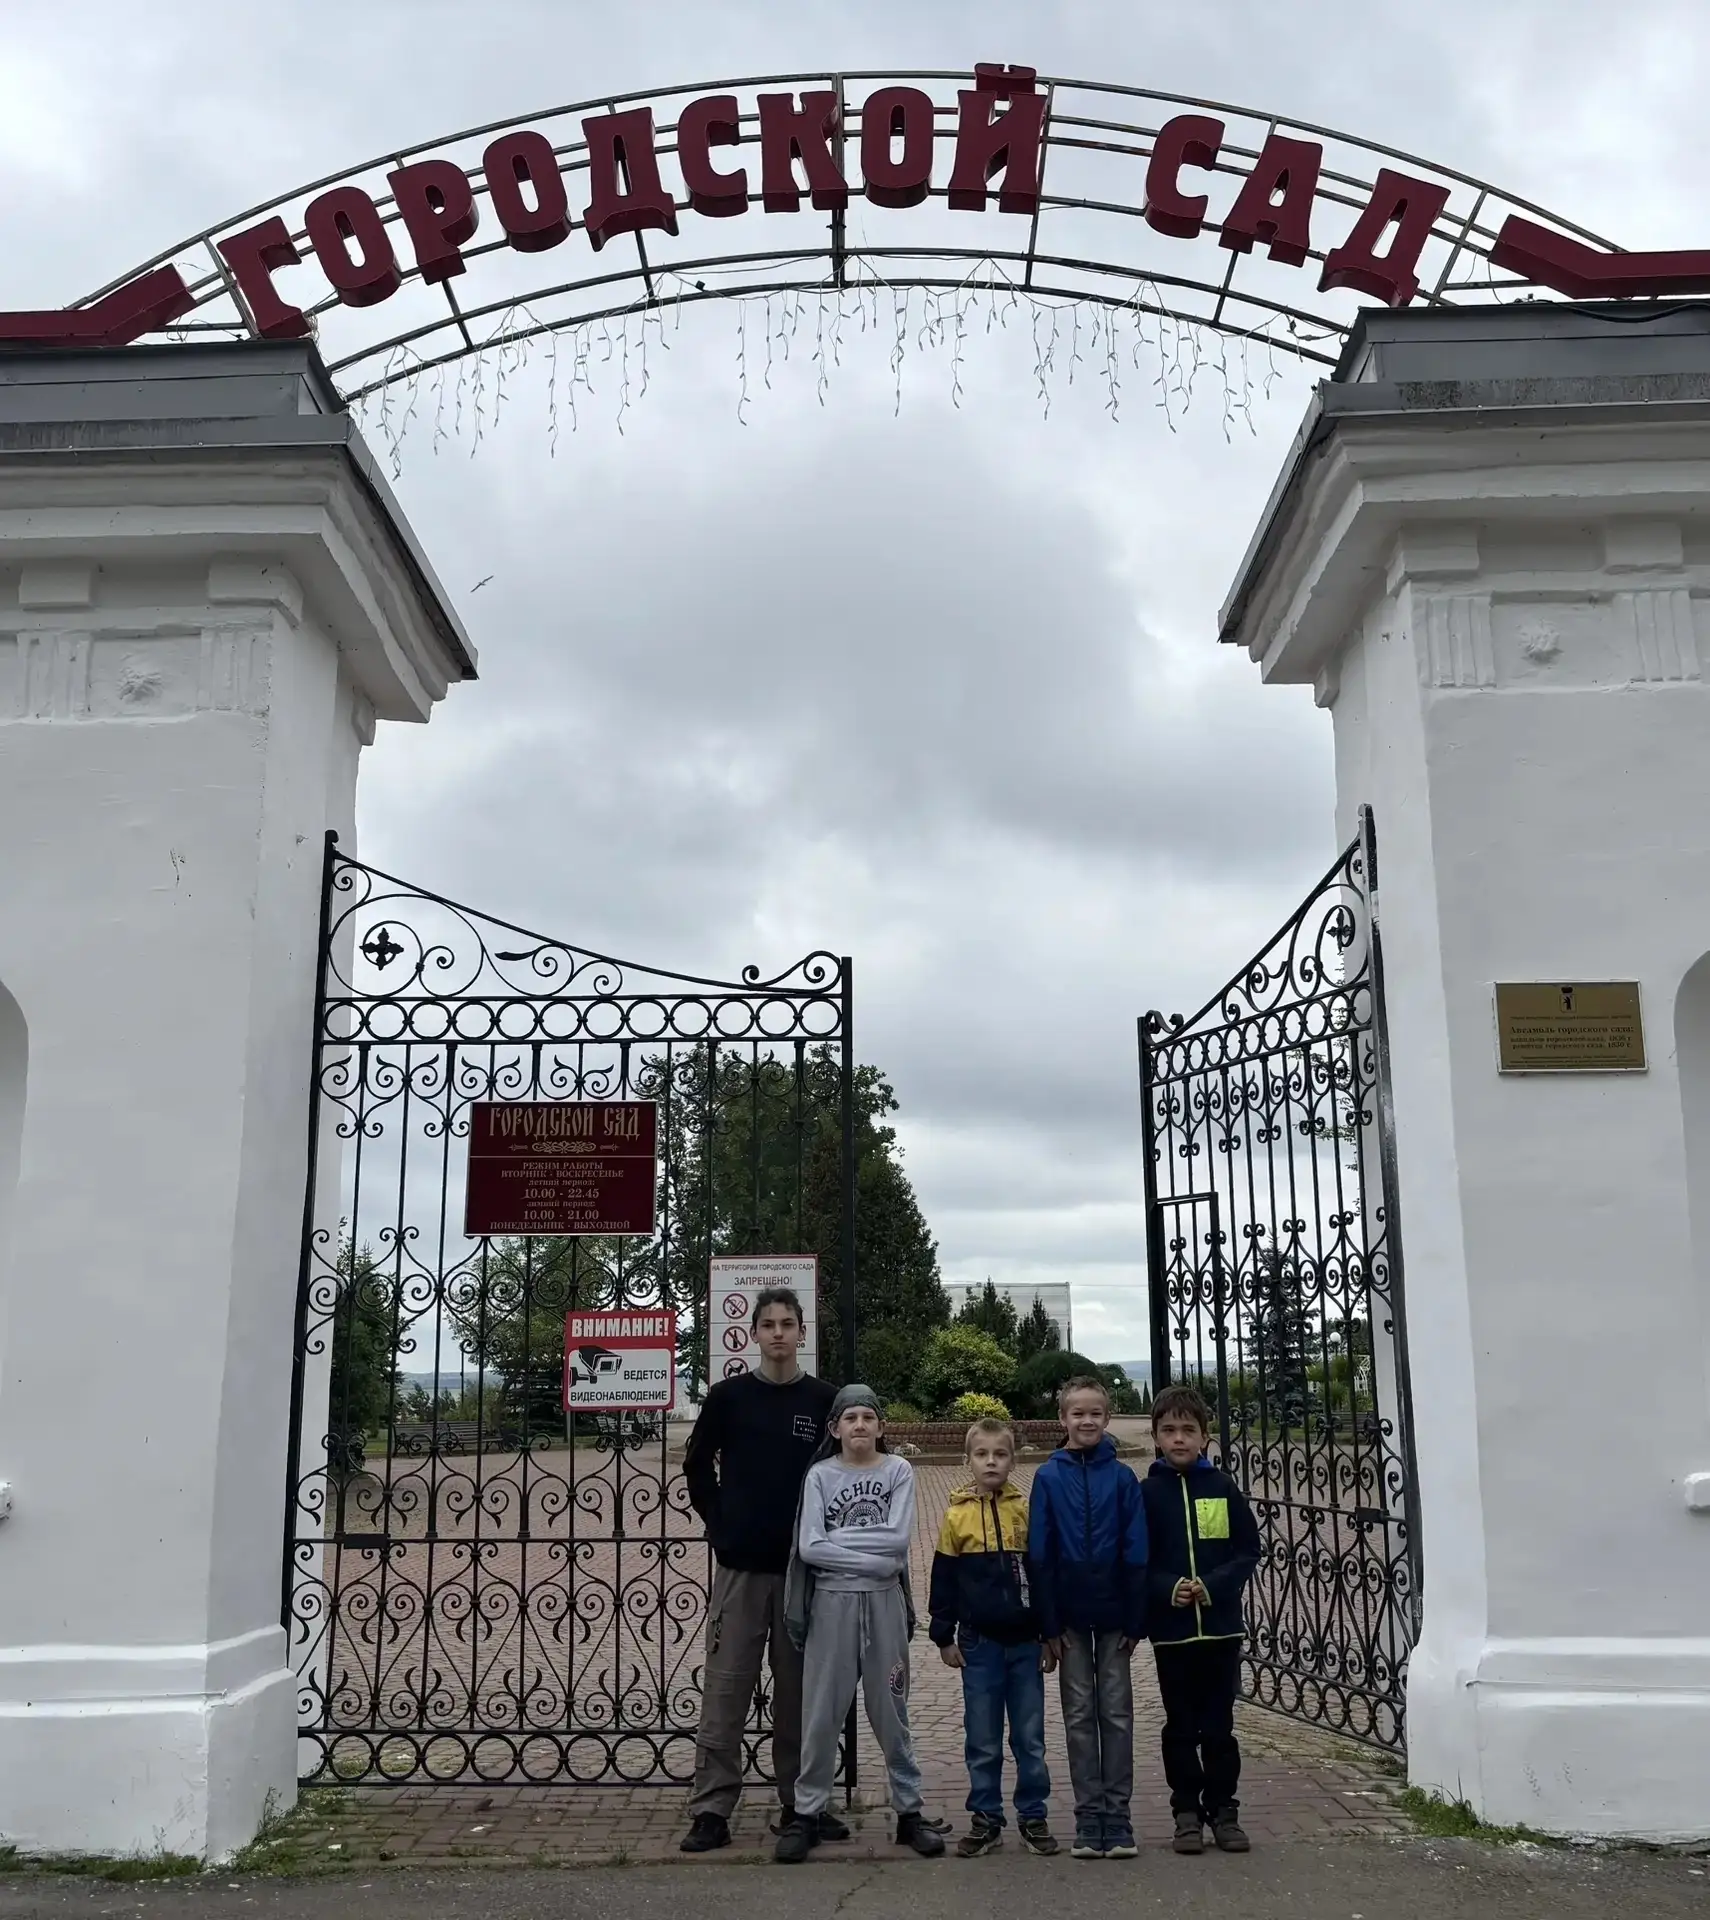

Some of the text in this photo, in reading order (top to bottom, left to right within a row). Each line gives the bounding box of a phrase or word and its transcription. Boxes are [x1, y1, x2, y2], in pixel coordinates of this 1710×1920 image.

[217, 62, 1451, 338] ГОРОДСКОЙ САД
[489, 1104, 640, 1141] ГОРОДСКОЙ САД
[523, 1162, 560, 1170] РЕЖИМ
[501, 1170, 547, 1178] ВТОРНИК
[556, 1170, 624, 1178] ВОСКРЕСЕНЬЕ
[562, 1179, 595, 1187] период:
[524, 1188, 556, 1199] 10.00
[568, 1188, 600, 1199] 22.45
[563, 1200, 596, 1208] период:
[524, 1210, 555, 1220] 10.00
[567, 1210, 600, 1220] 21.00
[490, 1222, 564, 1230] ПОНЕДЕЛЬНИК
[574, 1220, 630, 1230] ВЫХОДНОЙ
[734, 1276, 793, 1287] ЗАПРЕЩЕНО!
[571, 1317, 669, 1337] ВНИМАНИЕ!
[623, 1370, 667, 1381] ВЕДЕТСЯ
[570, 1390, 667, 1402] ВИДЕОНАБЛЮДЕНИЕ
[825, 1481, 892, 1521] MICHIGA
